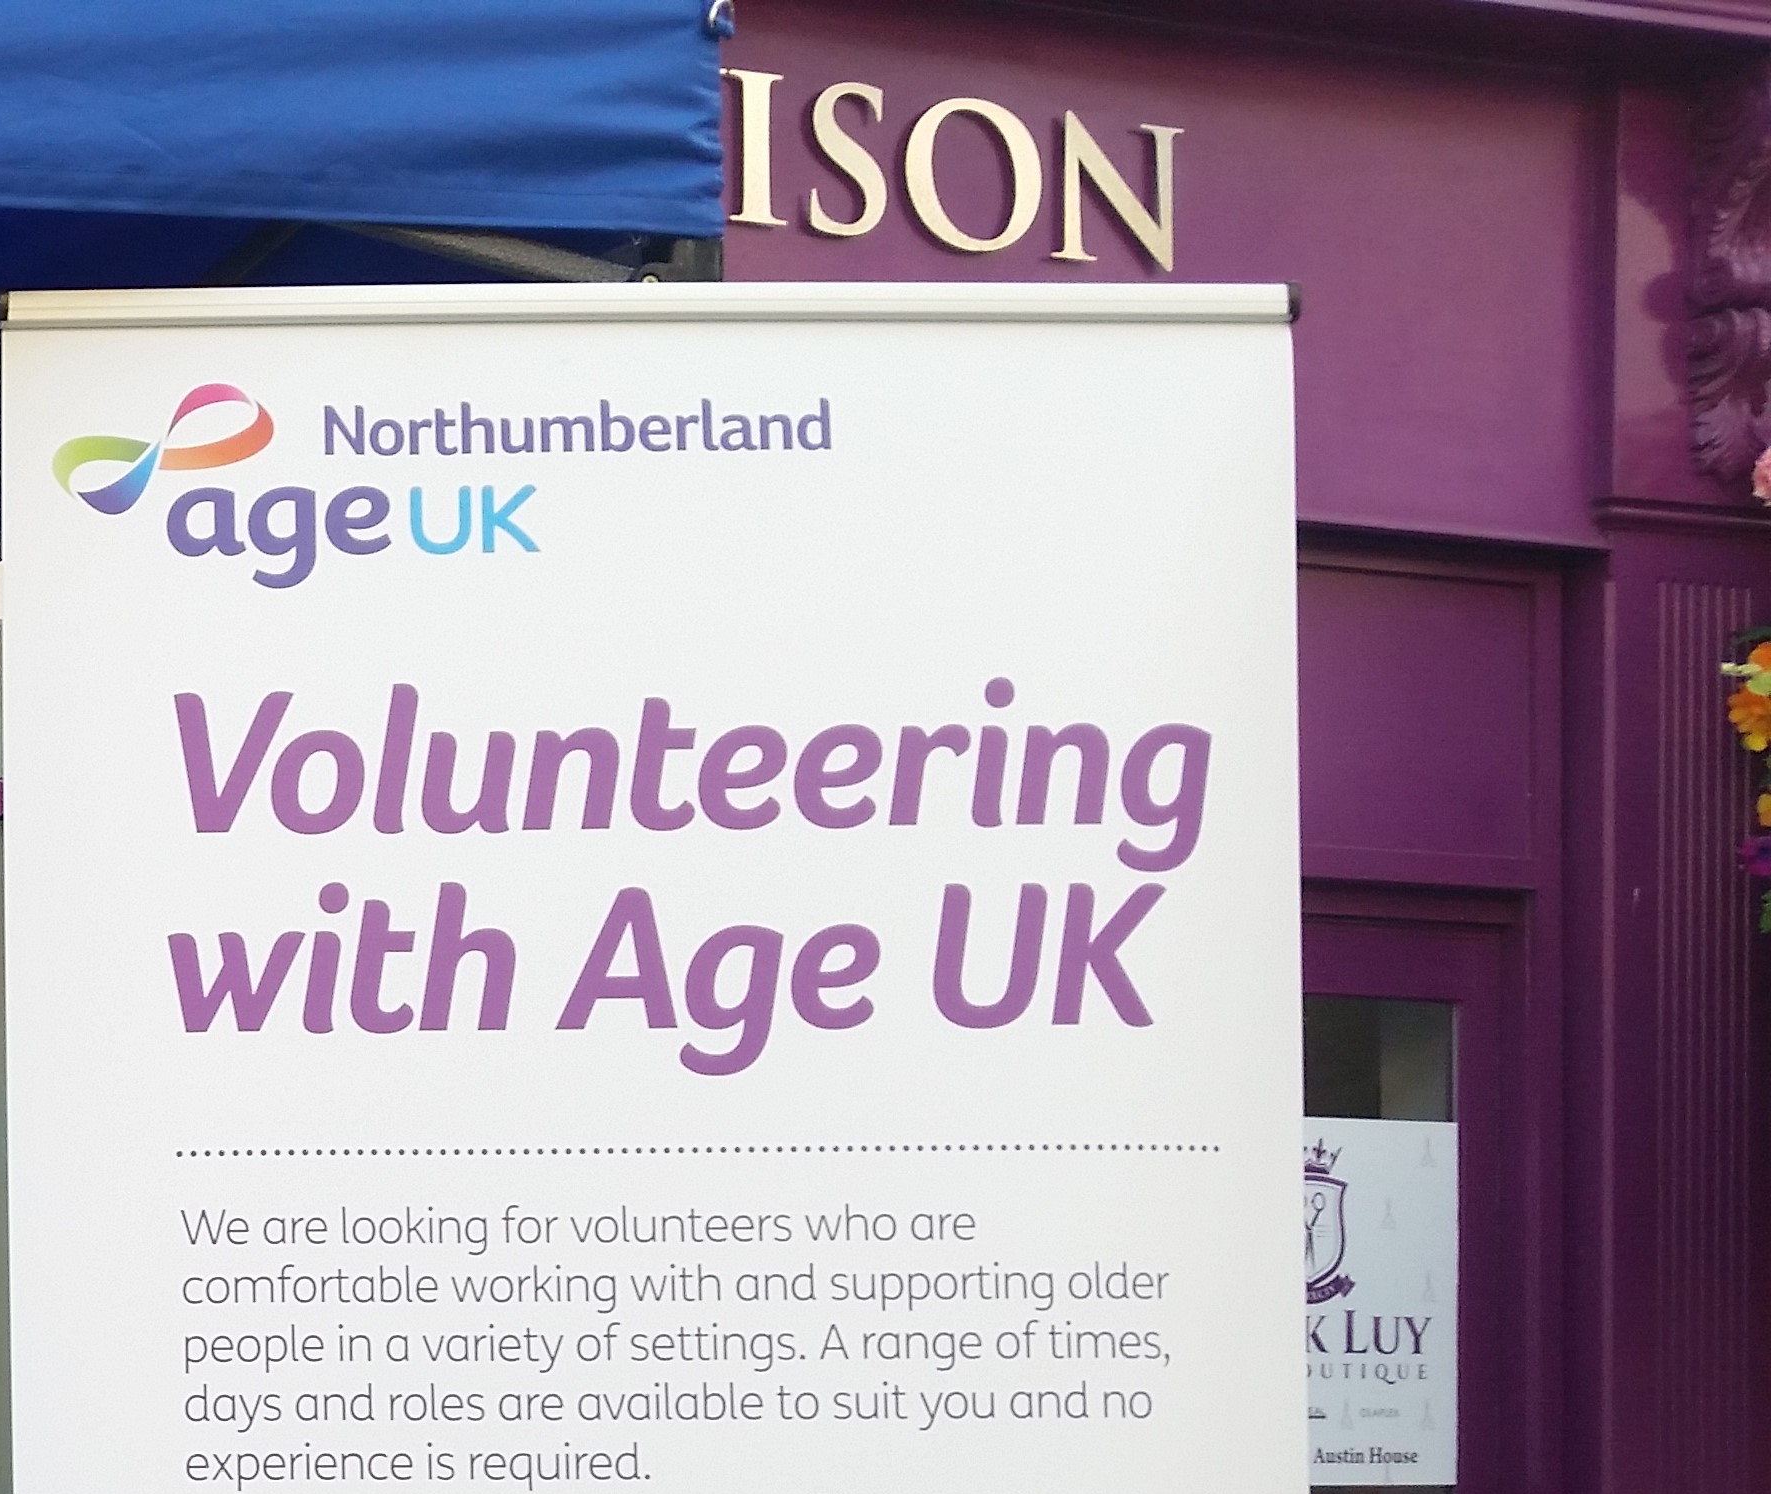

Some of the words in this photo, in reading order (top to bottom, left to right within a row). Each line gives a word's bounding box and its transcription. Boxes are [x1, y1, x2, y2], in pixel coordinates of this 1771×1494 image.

[720, 68, 1184, 272] ISON
[324, 398, 831, 456] Northumberland
[167, 486, 391, 589] age
[410, 485, 540, 555] UK
[174, 677, 1211, 872] Volunteering
[168, 882, 516, 1034] with
[555, 887, 880, 1076] Age
[933, 883, 1166, 1029] UK
[181, 1209, 249, 1245] We
[264, 1218, 327, 1244] are
[342, 1206, 487, 1255] looking
[502, 1205, 558, 1243] for
[571, 1205, 791, 1243] volunteers
[805, 1204, 896, 1241] who
[911, 1214, 975, 1240] are
[183, 1264, 438, 1304] comfortable
[452, 1265, 616, 1313] working
[631, 1264, 720, 1301] with
[736, 1263, 816, 1301] and
[831, 1262, 1053, 1311] supporting
[1069, 1261, 1169, 1299] older
[185, 1324, 324, 1374] people
[339, 1324, 371, 1361] in
[387, 1335, 408, 1362] a
[423, 1324, 563, 1373] variety
[577, 1322, 620, 1361] of
[631, 1323, 805, 1372] settings.
[820, 1324, 849, 1359] A
[864, 1332, 982, 1371] range
[997, 1320, 1039, 1359] of
[1049, 1321, 1169, 1366] times,
[185, 1384, 281, 1433] days
[296, 1383, 374, 1421] and
[390, 1383, 484, 1421] roles
[499, 1394, 563, 1421] are
[578, 1382, 763, 1420] available
[777, 1386, 819, 1420] to
[834, 1381, 907, 1419] suit
[919, 1392, 994, 1430] you
[1010, 1381, 1088, 1418] and
[1104, 1392, 1152, 1418] no
[186, 1442, 413, 1491] experience
[427, 1442, 454, 1480] is
[470, 1442, 650, 1491] required.
[1313, 1448, 1364, 1464] Austin
[1369, 1447, 1418, 1464] House
